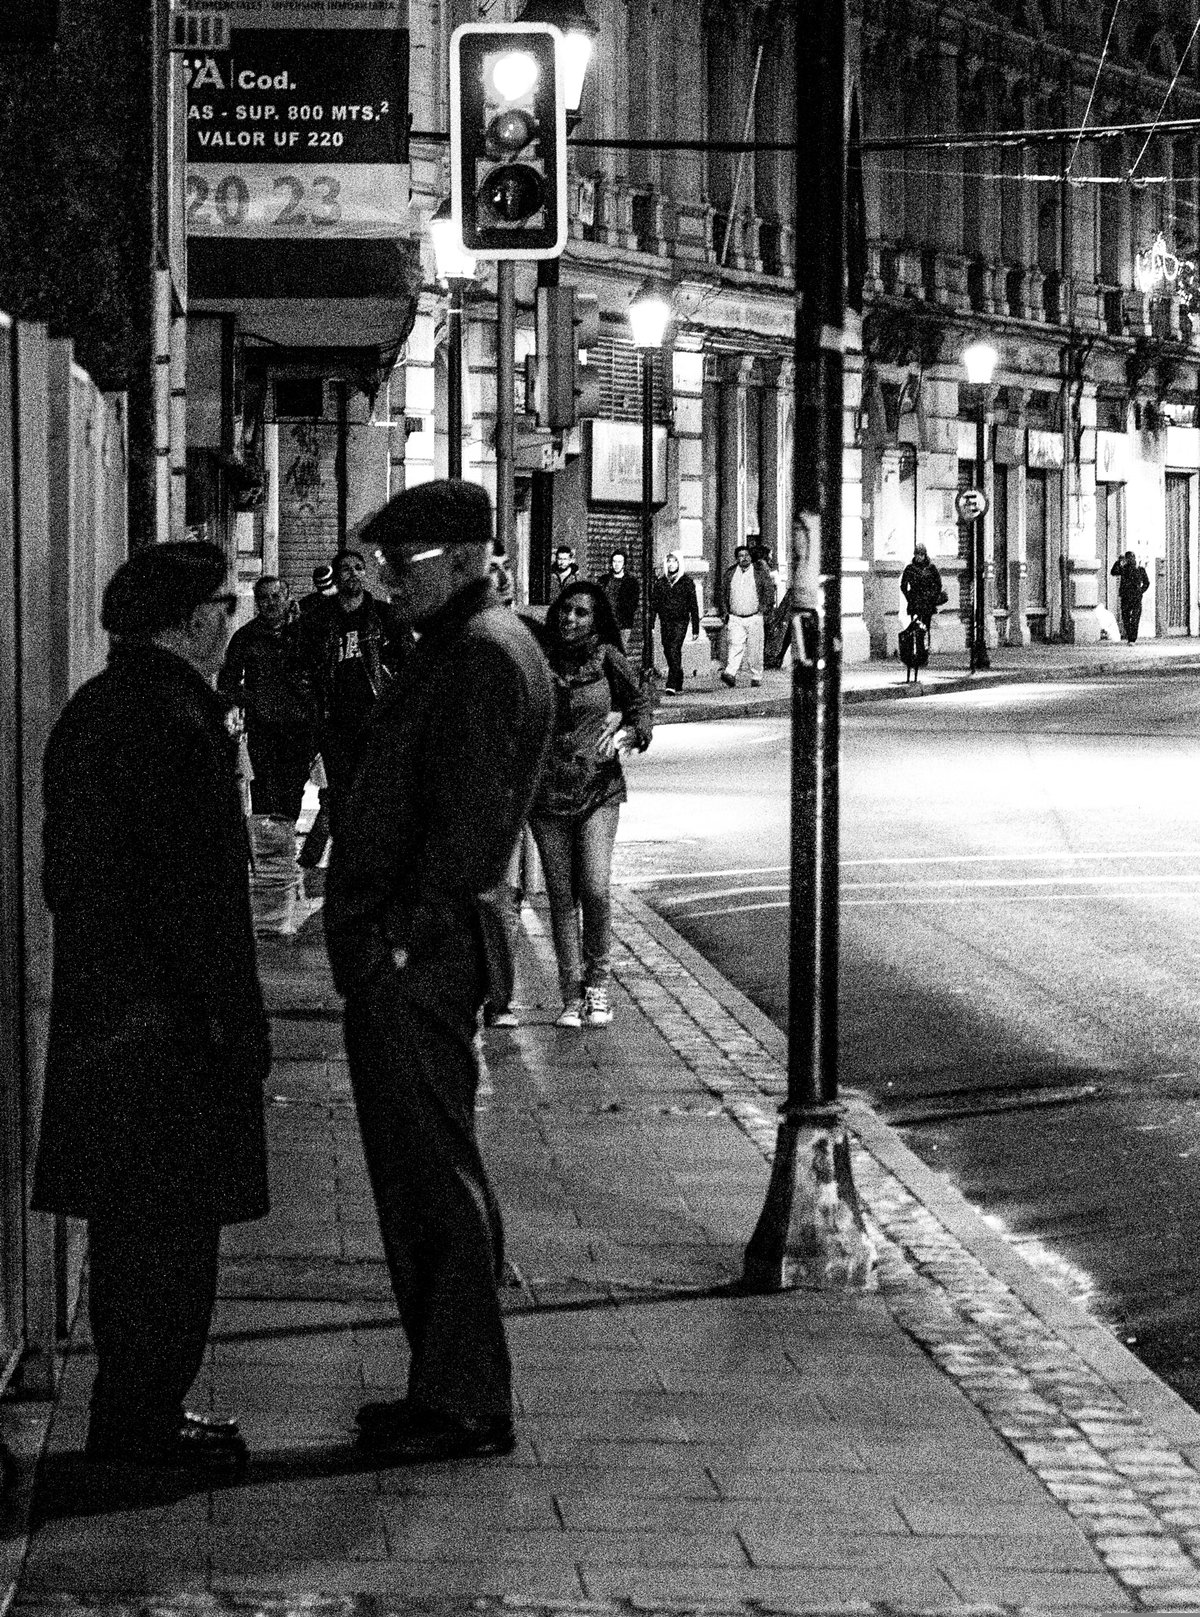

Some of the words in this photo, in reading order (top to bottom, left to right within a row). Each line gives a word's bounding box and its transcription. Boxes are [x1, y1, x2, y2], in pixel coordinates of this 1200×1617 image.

[238, 69, 297, 90] Cod.
[188, 104, 214, 120] AS
[235, 104, 280, 120] SUP.
[287, 104, 323, 121] 800
[197, 131, 265, 147] VALOR
[273, 131, 300, 147] UF
[307, 131, 344, 147] 220
